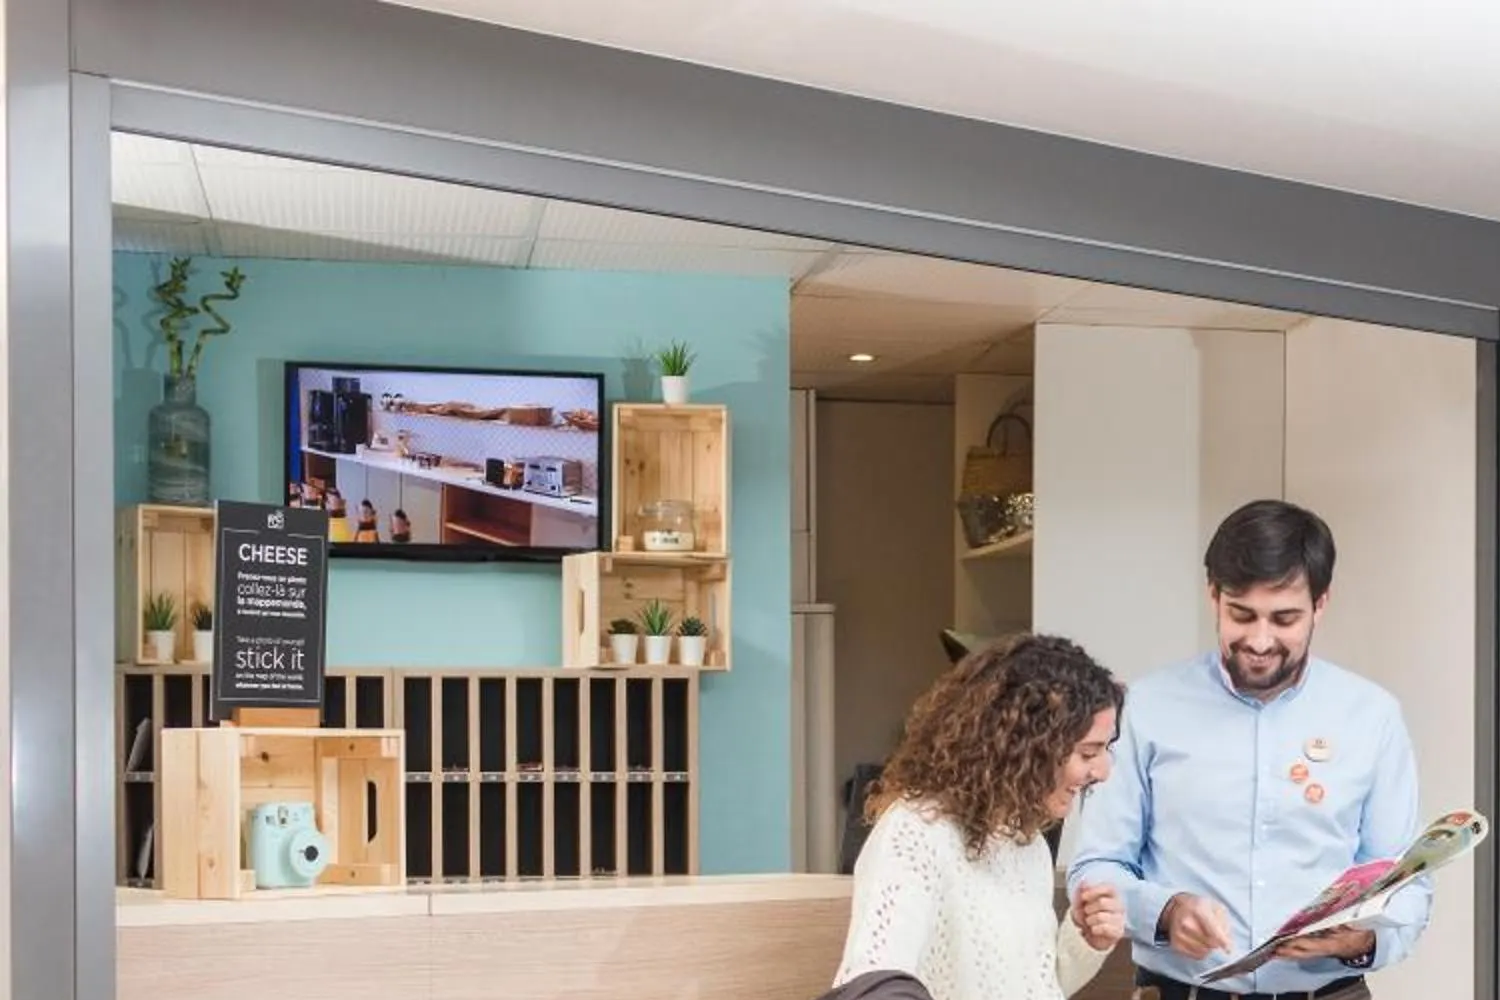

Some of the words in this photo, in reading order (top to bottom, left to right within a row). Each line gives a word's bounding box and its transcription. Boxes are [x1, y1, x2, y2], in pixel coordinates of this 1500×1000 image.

[238, 543, 308, 566] CHEESE
[235, 646, 285, 669] stick
[292, 647, 305, 671] it
